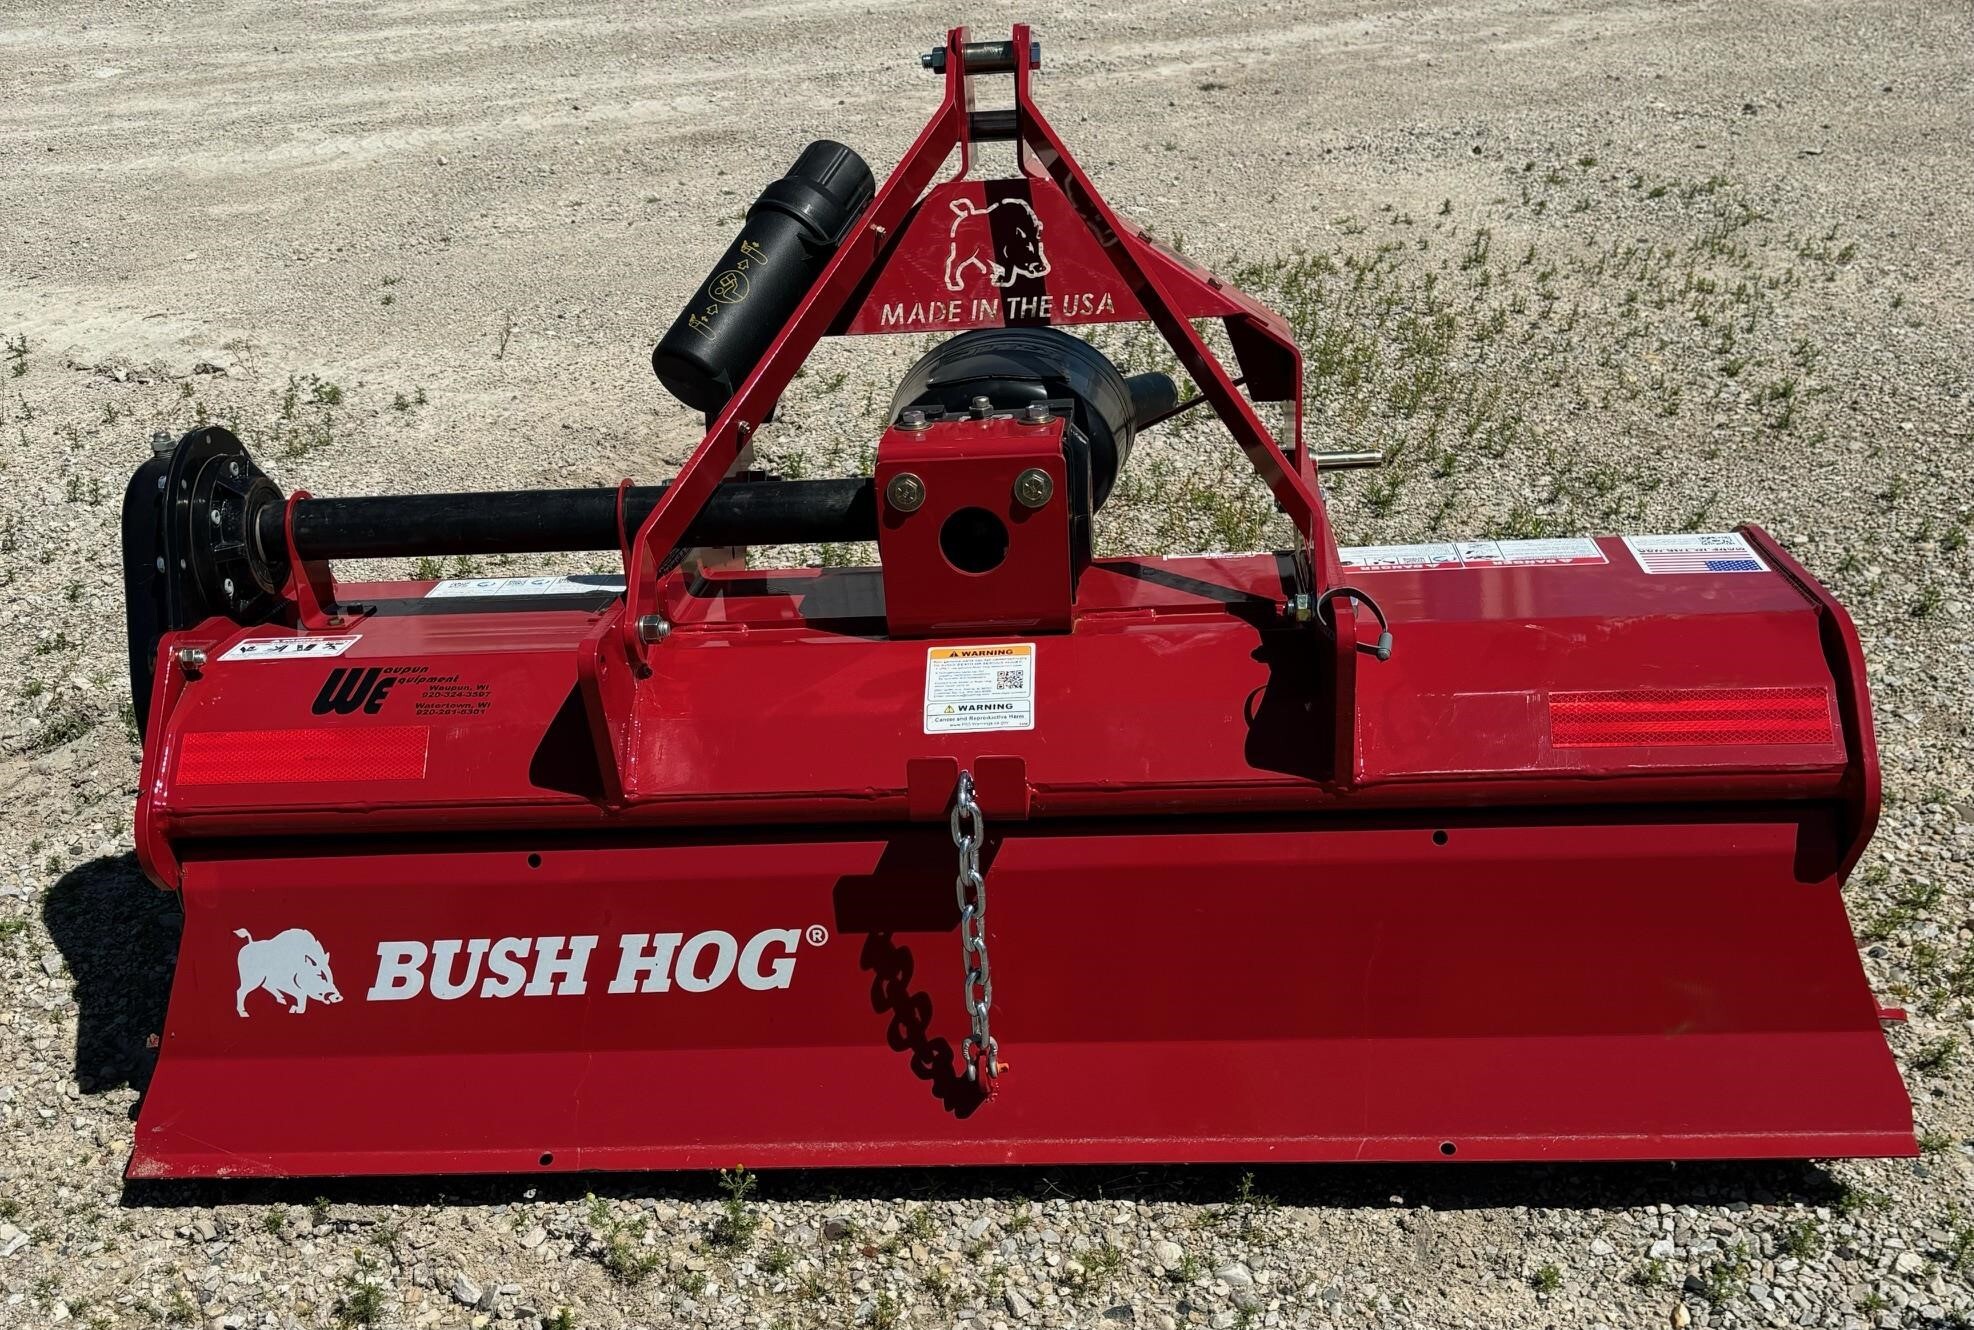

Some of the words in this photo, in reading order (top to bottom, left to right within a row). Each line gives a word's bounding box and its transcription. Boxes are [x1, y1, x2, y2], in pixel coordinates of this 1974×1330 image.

[880, 300, 963, 326] MADE
[970, 298, 999, 322] IN
[1007, 295, 1054, 320] THE
[1063, 292, 1116, 317] USA
[961, 649, 1014, 658] WARNING
[958, 703, 1014, 712] WARNING
[366, 935, 600, 1001] BUSH
